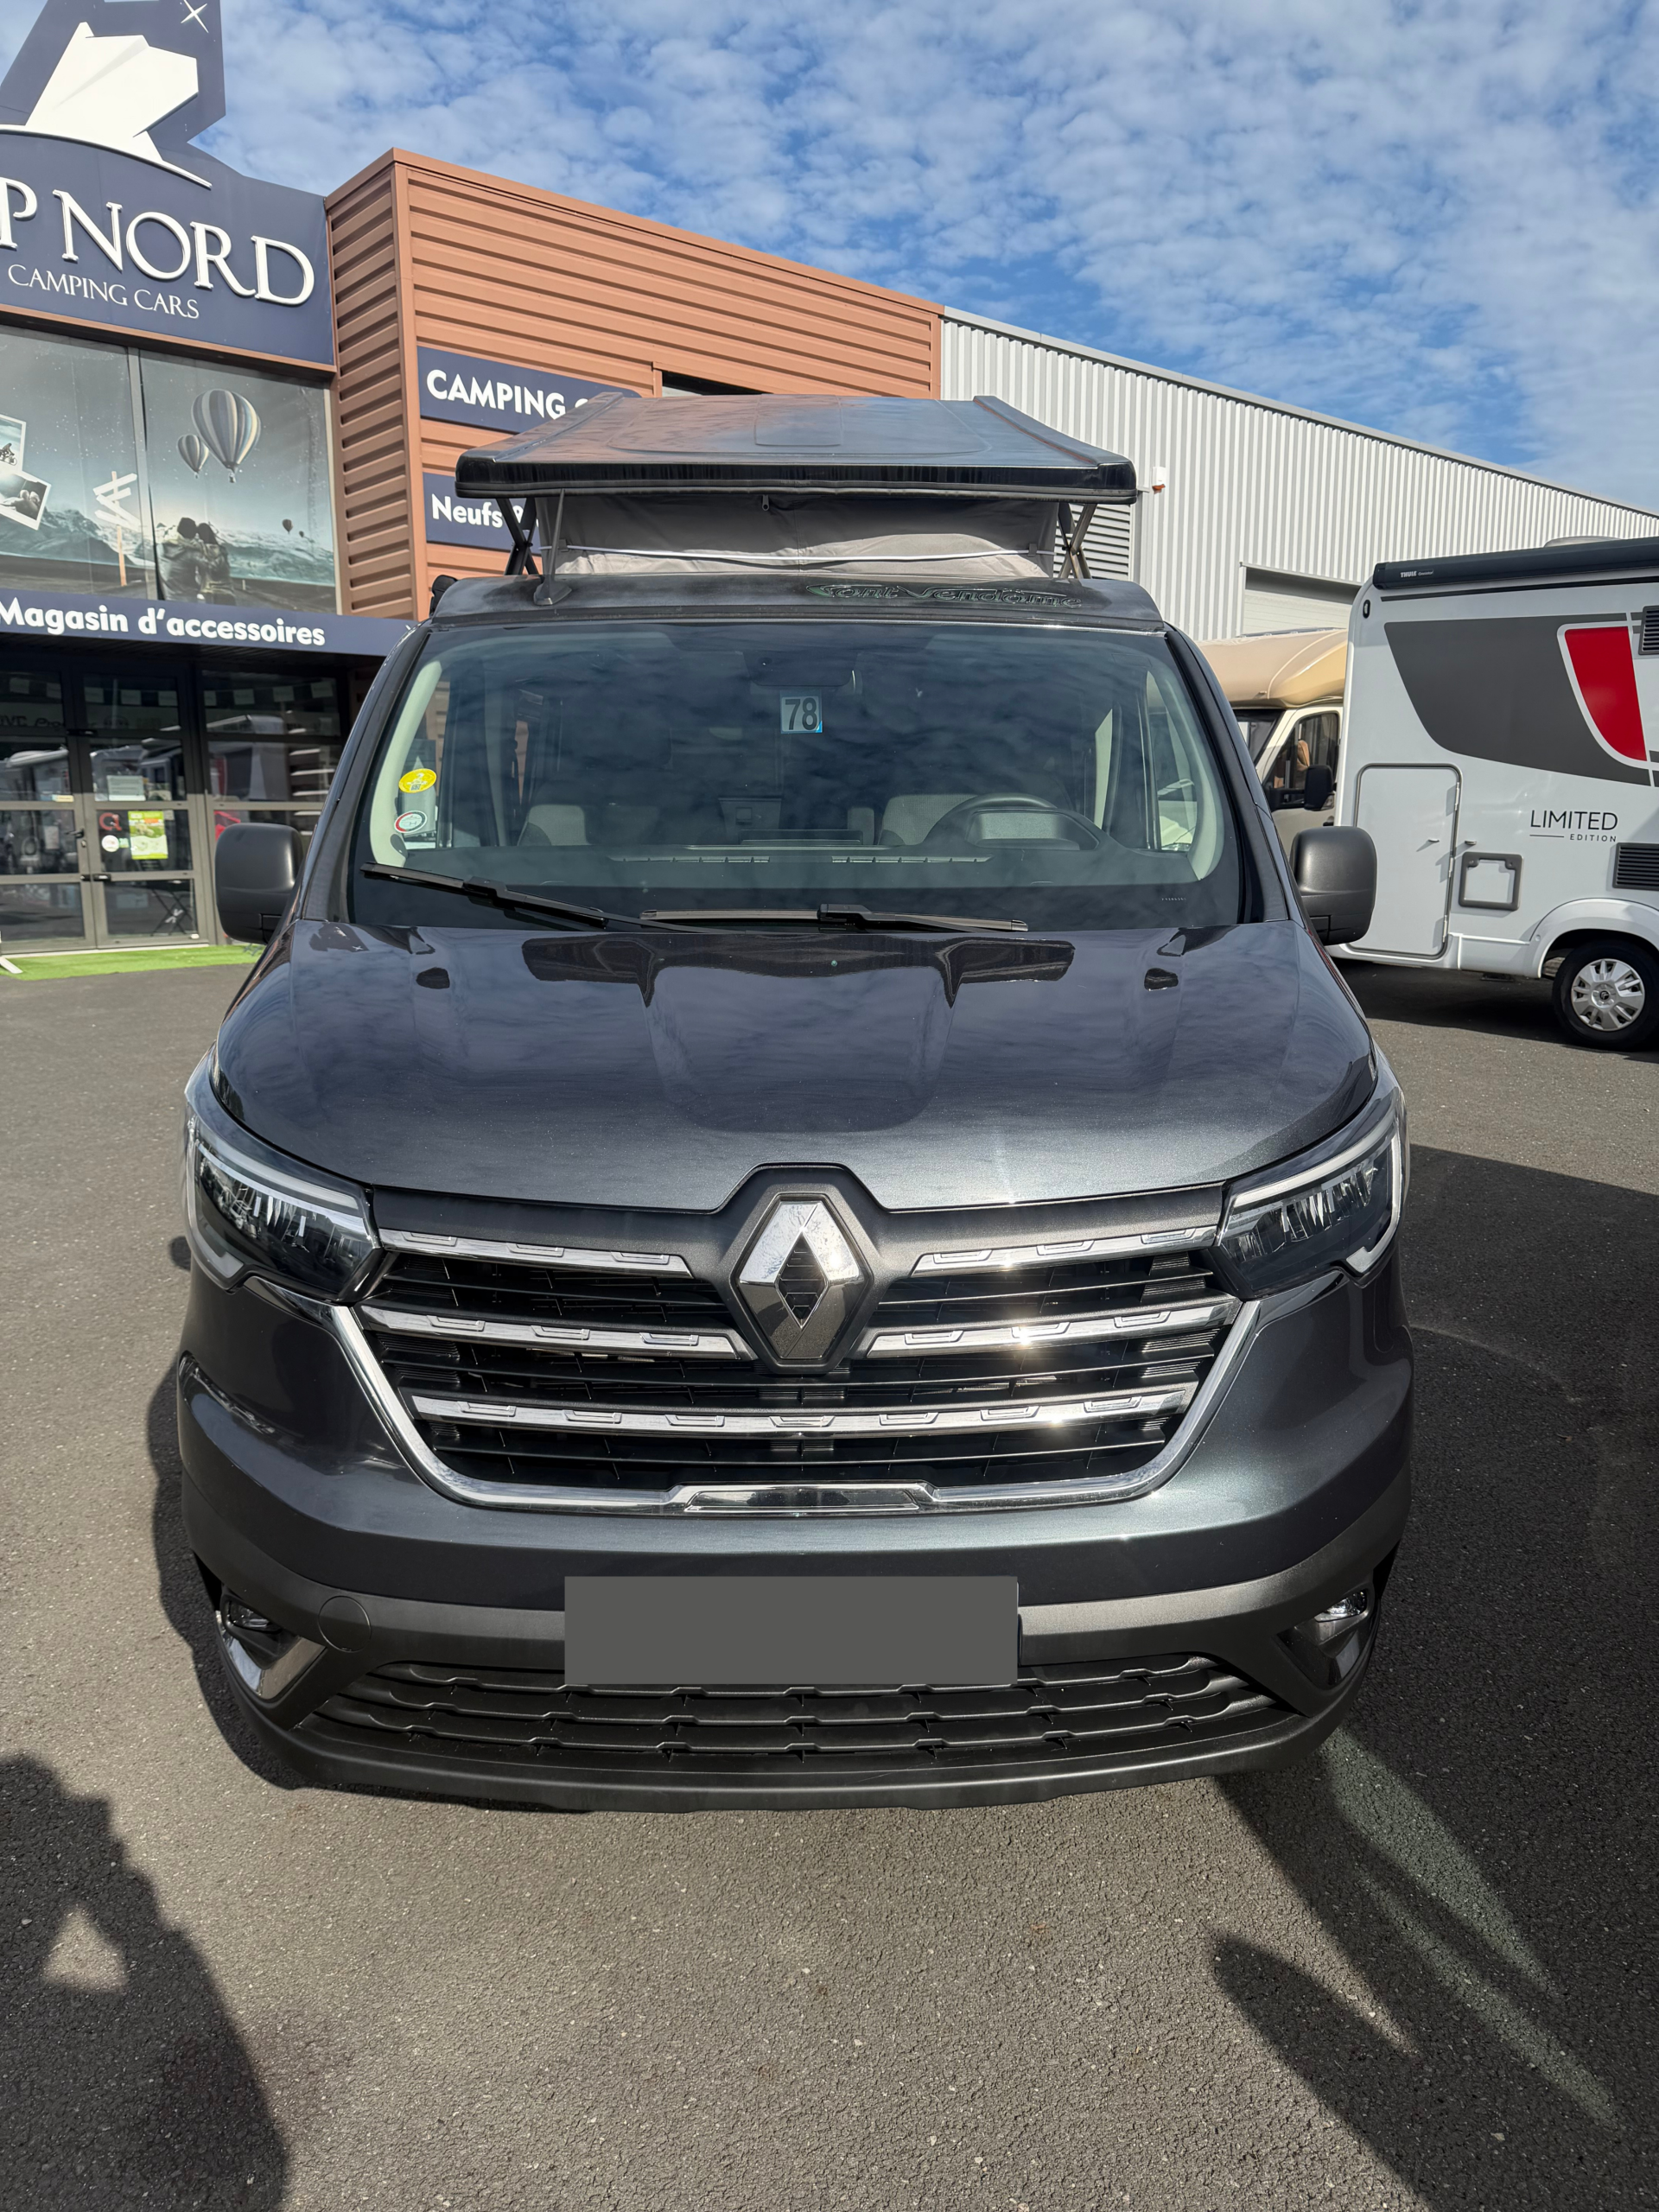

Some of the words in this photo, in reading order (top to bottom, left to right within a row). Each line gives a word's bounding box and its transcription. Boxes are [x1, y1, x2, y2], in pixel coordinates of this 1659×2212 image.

[52, 189, 315, 306] NORD
[8, 264, 128, 306] CAMPING
[134, 289, 200, 319] CARS
[426, 369, 566, 420] CAMPING
[432, 493, 503, 528] Neufs
[0, 597, 129, 635] Magasin
[138, 607, 326, 646] d'accessoires
[785, 697, 818, 731] 78
[1530, 810, 1618, 830] LIMITED
[1570, 834, 1617, 842] EDITION
